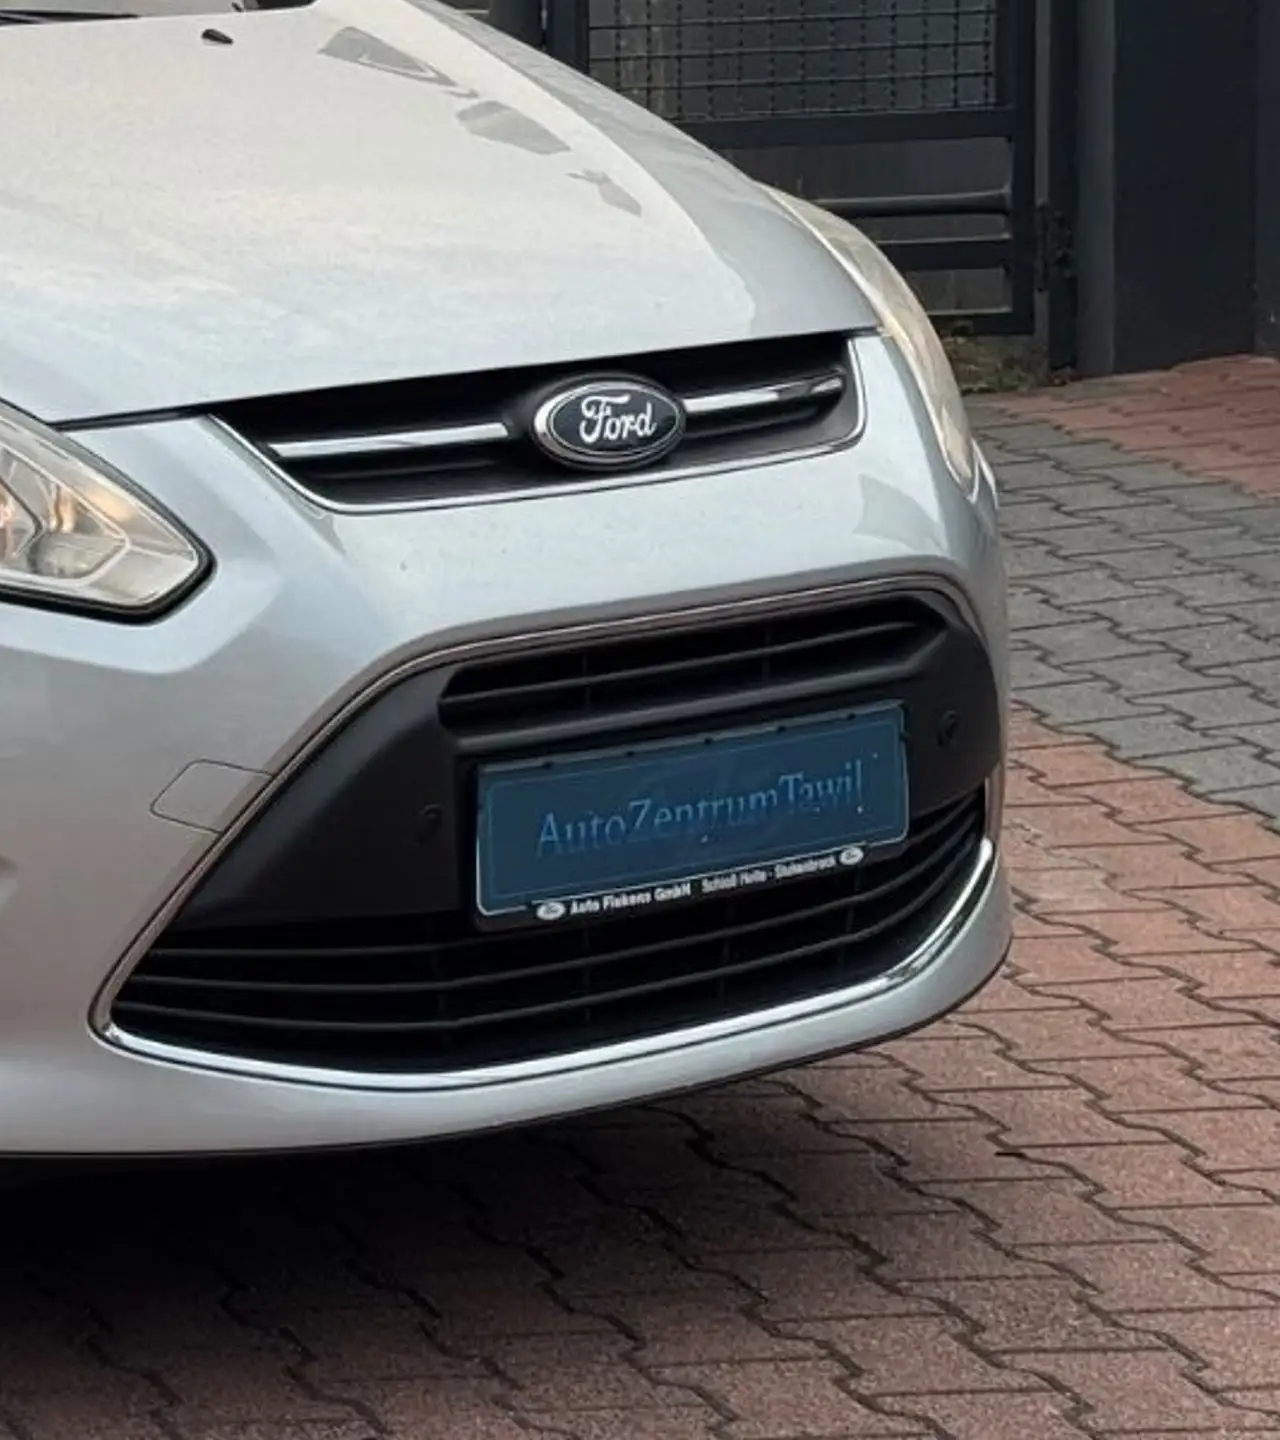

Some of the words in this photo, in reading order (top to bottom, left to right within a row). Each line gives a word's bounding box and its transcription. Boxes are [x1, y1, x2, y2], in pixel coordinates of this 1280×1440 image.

[578, 392, 658, 444] Ford
[570, 899, 600, 915] Auto
[654, 882, 691, 902] GmbH
